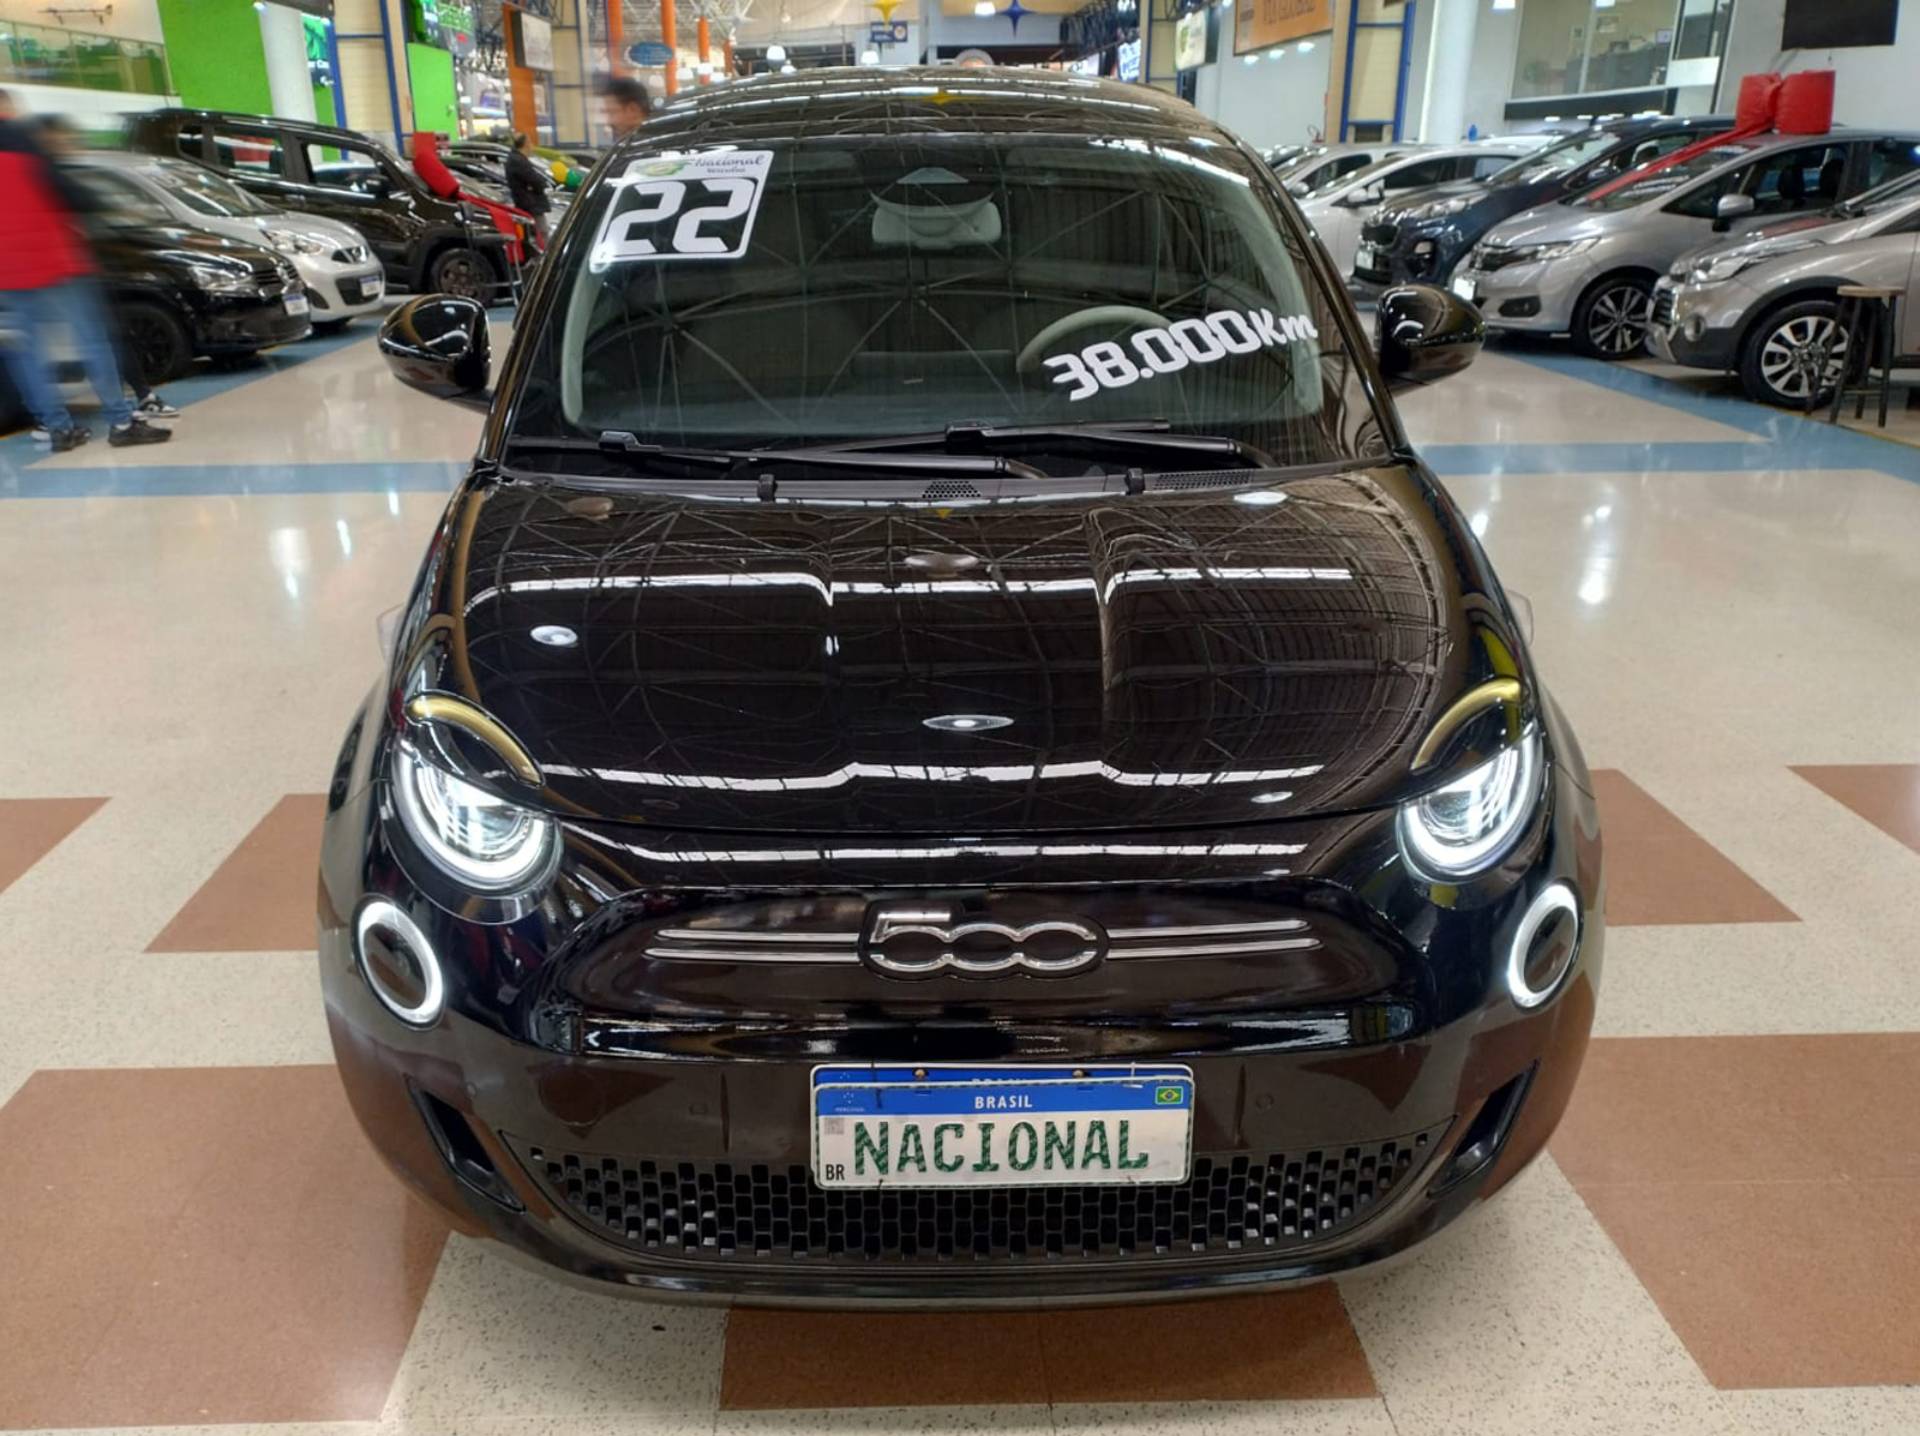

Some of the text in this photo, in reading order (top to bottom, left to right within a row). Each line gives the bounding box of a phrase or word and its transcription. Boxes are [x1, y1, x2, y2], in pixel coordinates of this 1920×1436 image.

[602, 177, 756, 254] 22
[869, 911, 1097, 972] 500
[974, 1095, 1033, 1110] BRASIL
[825, 1164, 846, 1181] BR
[854, 1120, 1149, 1176] NACIONAL
